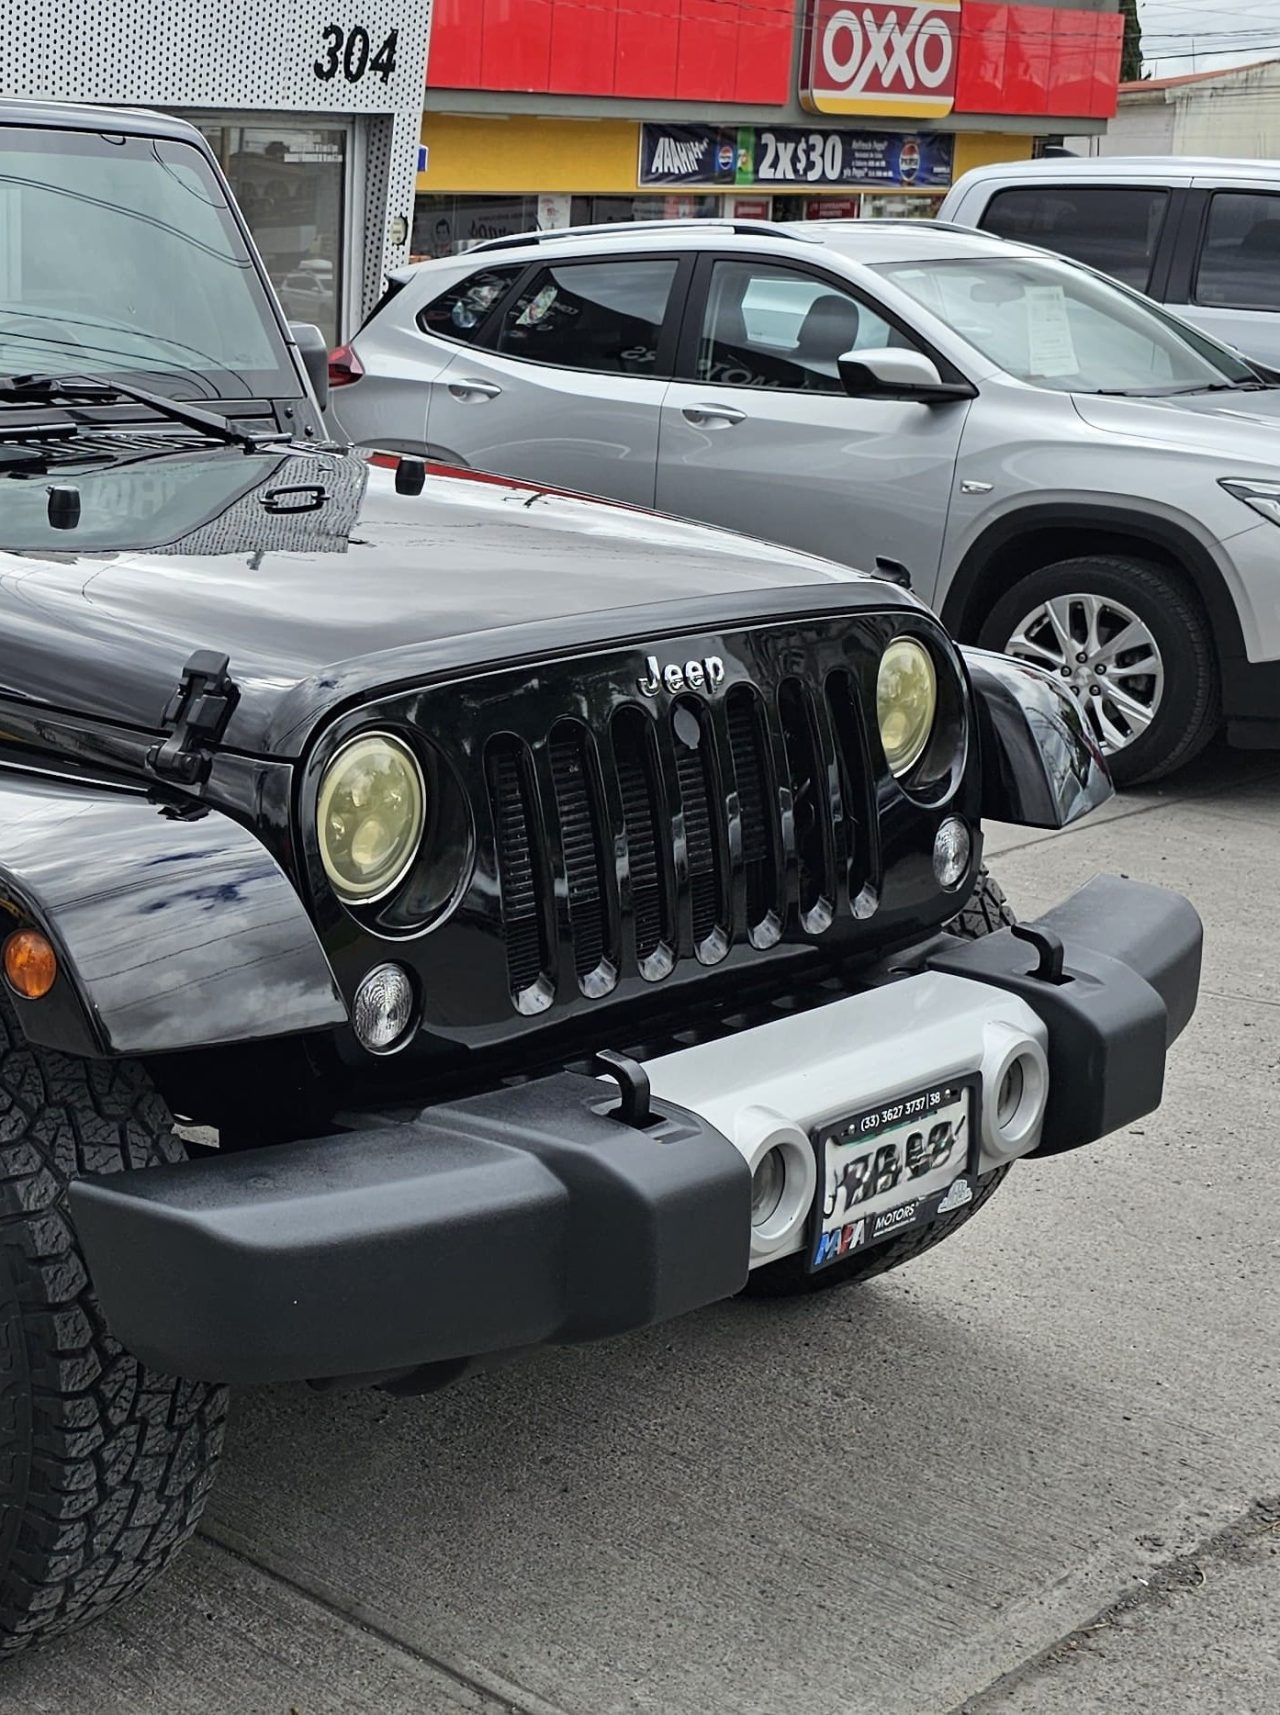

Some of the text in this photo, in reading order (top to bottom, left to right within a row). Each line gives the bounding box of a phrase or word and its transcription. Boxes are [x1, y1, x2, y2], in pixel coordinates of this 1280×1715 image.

[313, 23, 400, 85] 304
[822, 8, 953, 93] OXXO
[637, 655, 725, 698] Jeep
[860, 1113, 880, 1132] (33)
[881, 1105, 904, 1124] 3627
[814, 1219, 866, 1266] MAPA
[875, 1203, 916, 1231] MOTORS
